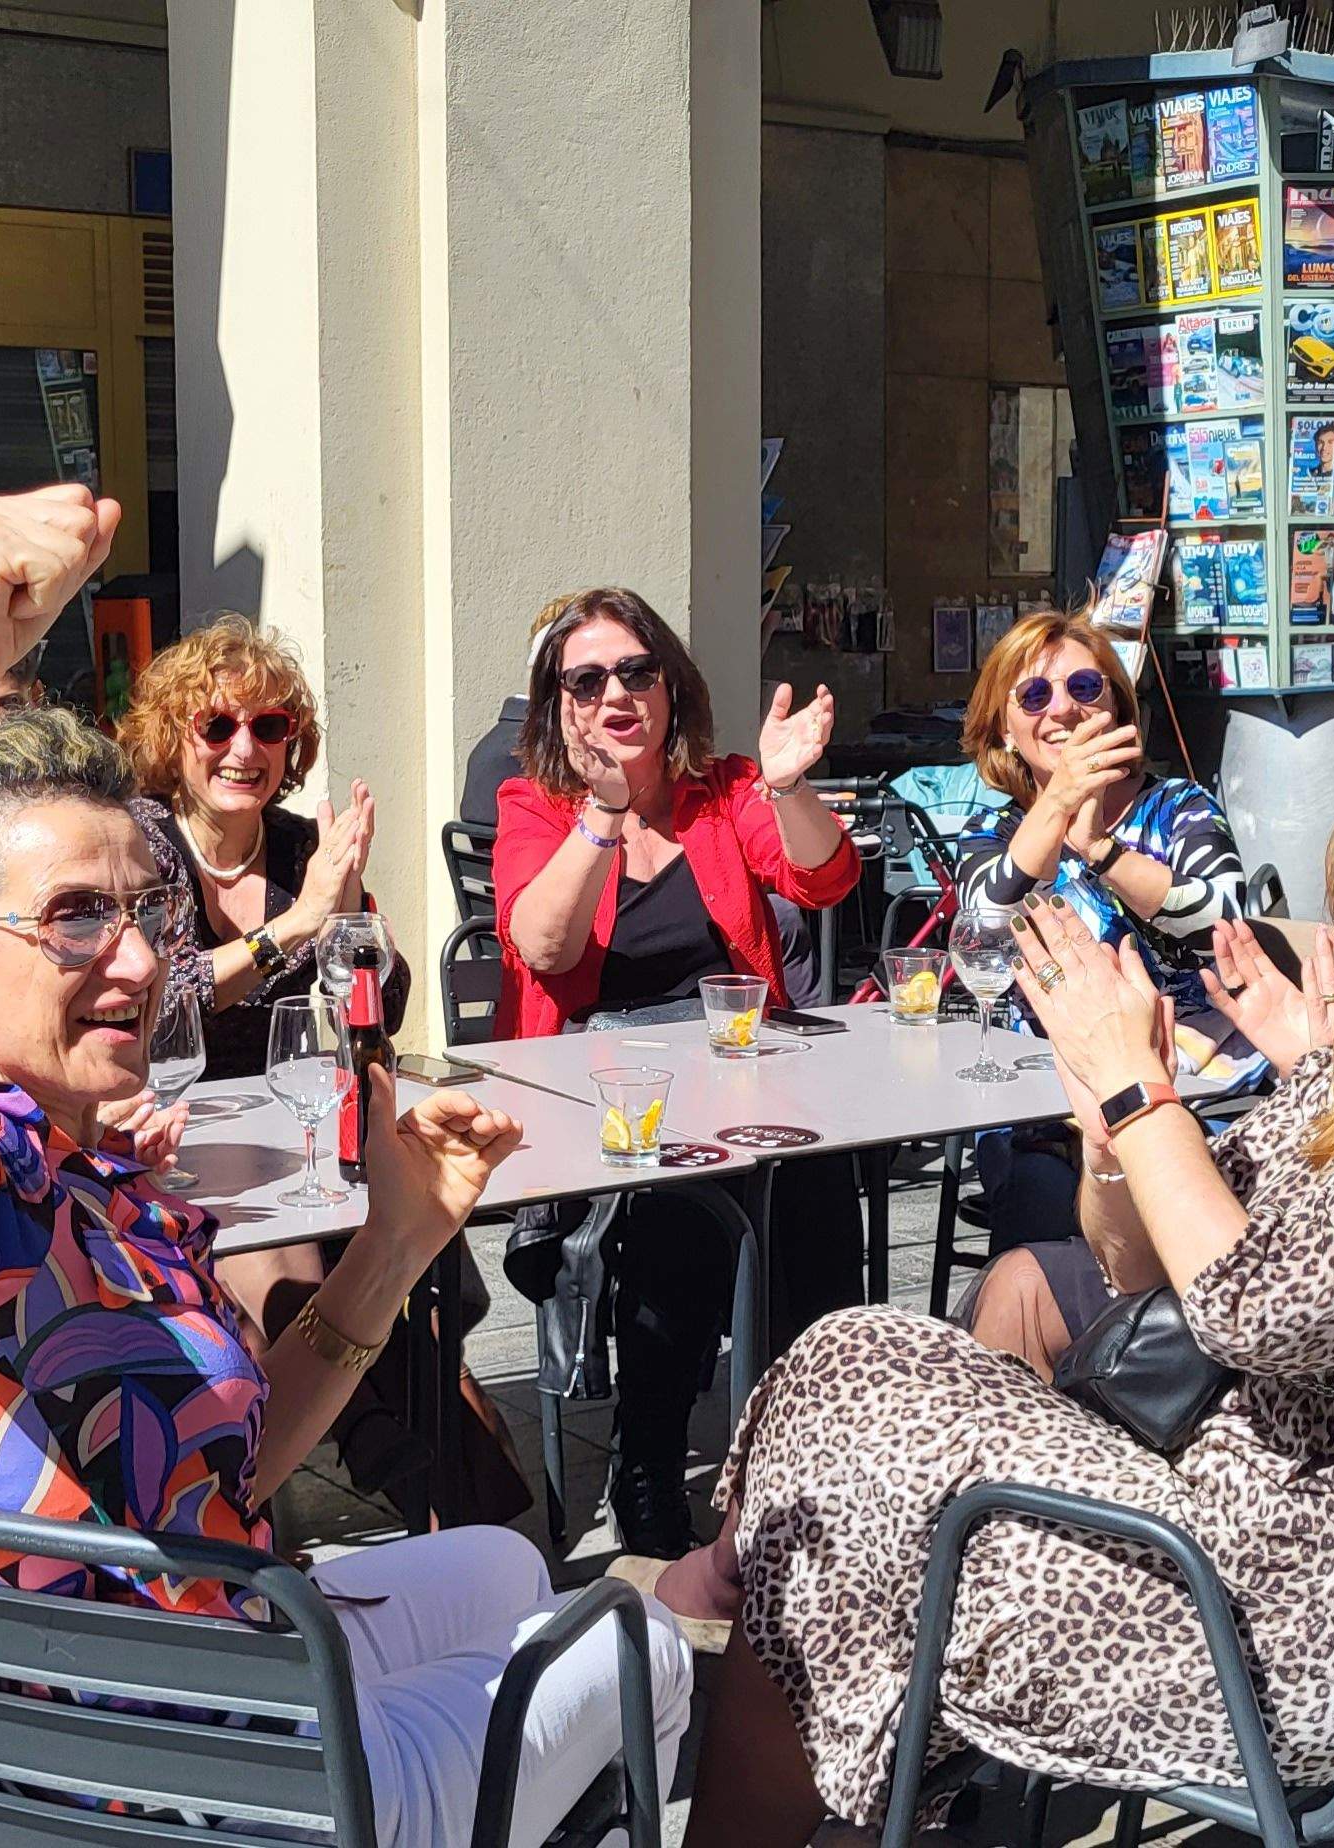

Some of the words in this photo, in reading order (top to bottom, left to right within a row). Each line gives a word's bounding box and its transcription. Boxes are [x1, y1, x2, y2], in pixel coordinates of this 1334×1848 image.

[1209, 86, 1252, 108] VIAJES
[1162, 95, 1205, 118] VIAJES
[1212, 160, 1251, 176] LONDRES
[1217, 211, 1252, 227] VIAJES
[1182, 544, 1216, 559] muy
[1223, 542, 1258, 557] muy
